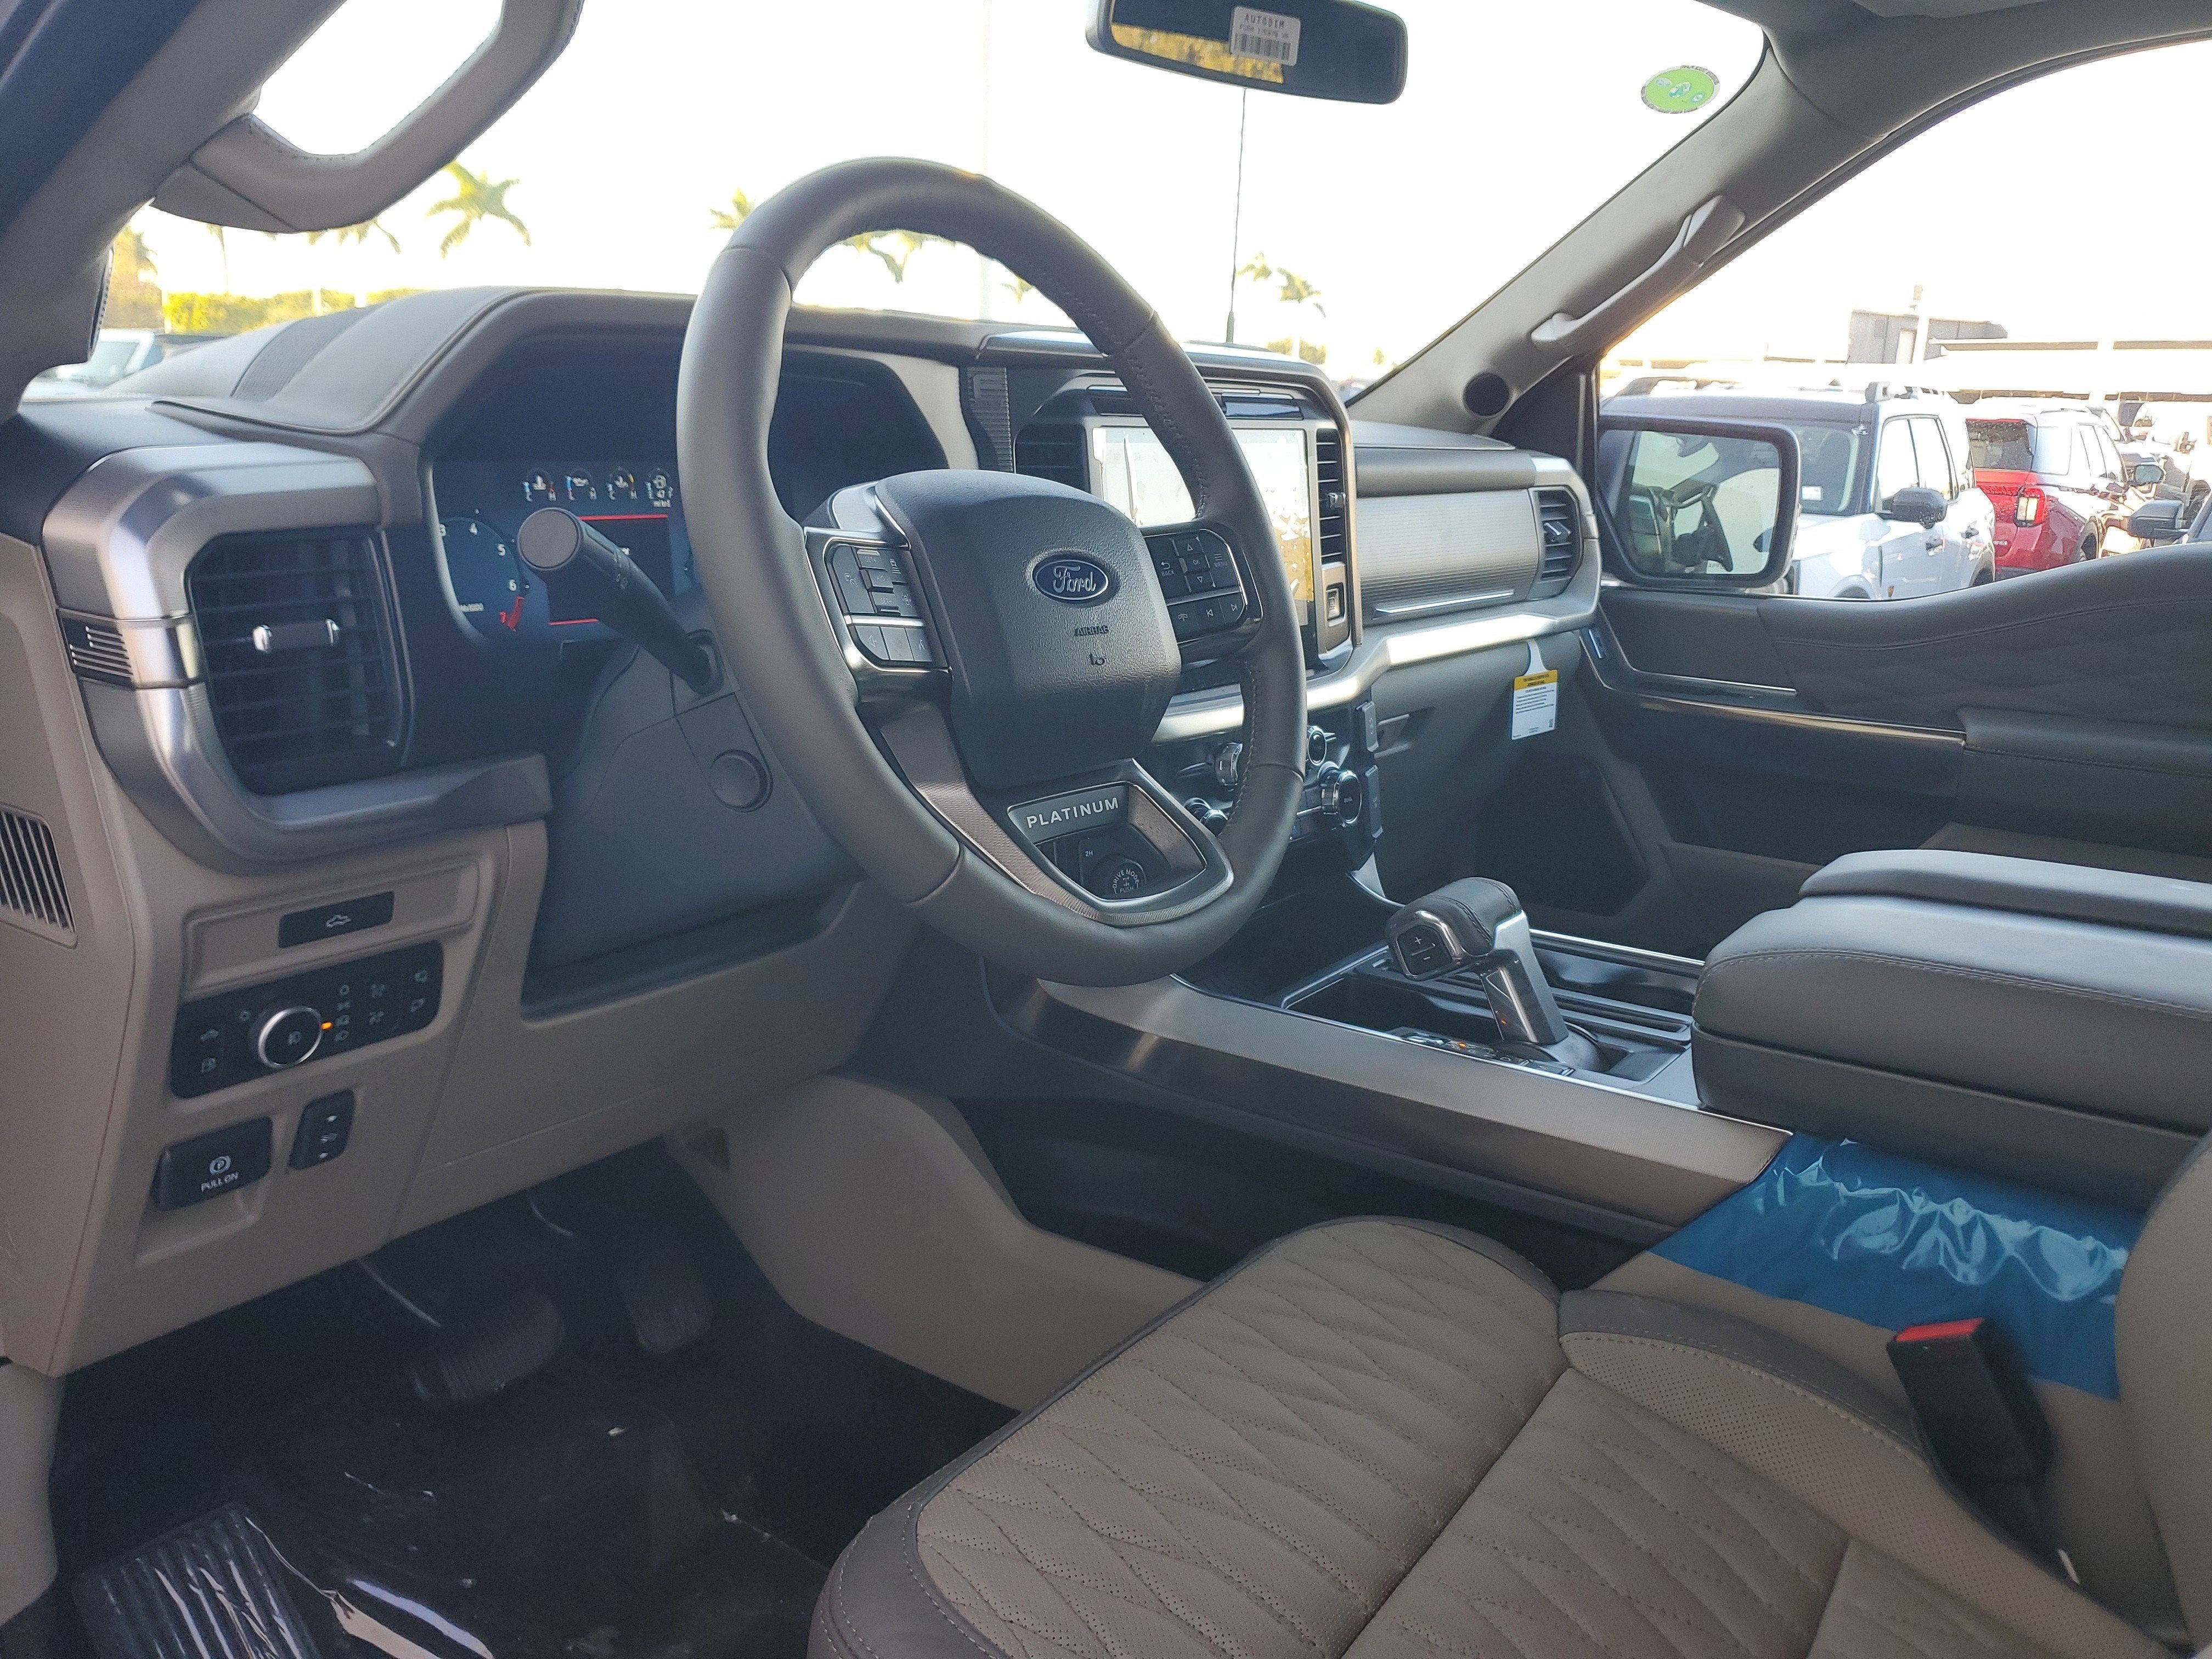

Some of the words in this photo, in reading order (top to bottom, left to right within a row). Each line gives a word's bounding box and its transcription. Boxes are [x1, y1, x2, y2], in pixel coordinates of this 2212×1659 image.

[497, 544, 506, 556] 5
[509, 579, 517, 591] 6
[1052, 566, 1096, 593] Ford
[1074, 625, 1109, 637] AIRBAG
[1026, 797, 1119, 828] PLATINUM
[1112, 870, 1125, 889] DRIVE
[1125, 868, 1139, 884] MODE
[201, 1178, 223, 1193] PULL
[224, 1171, 239, 1183] ON
